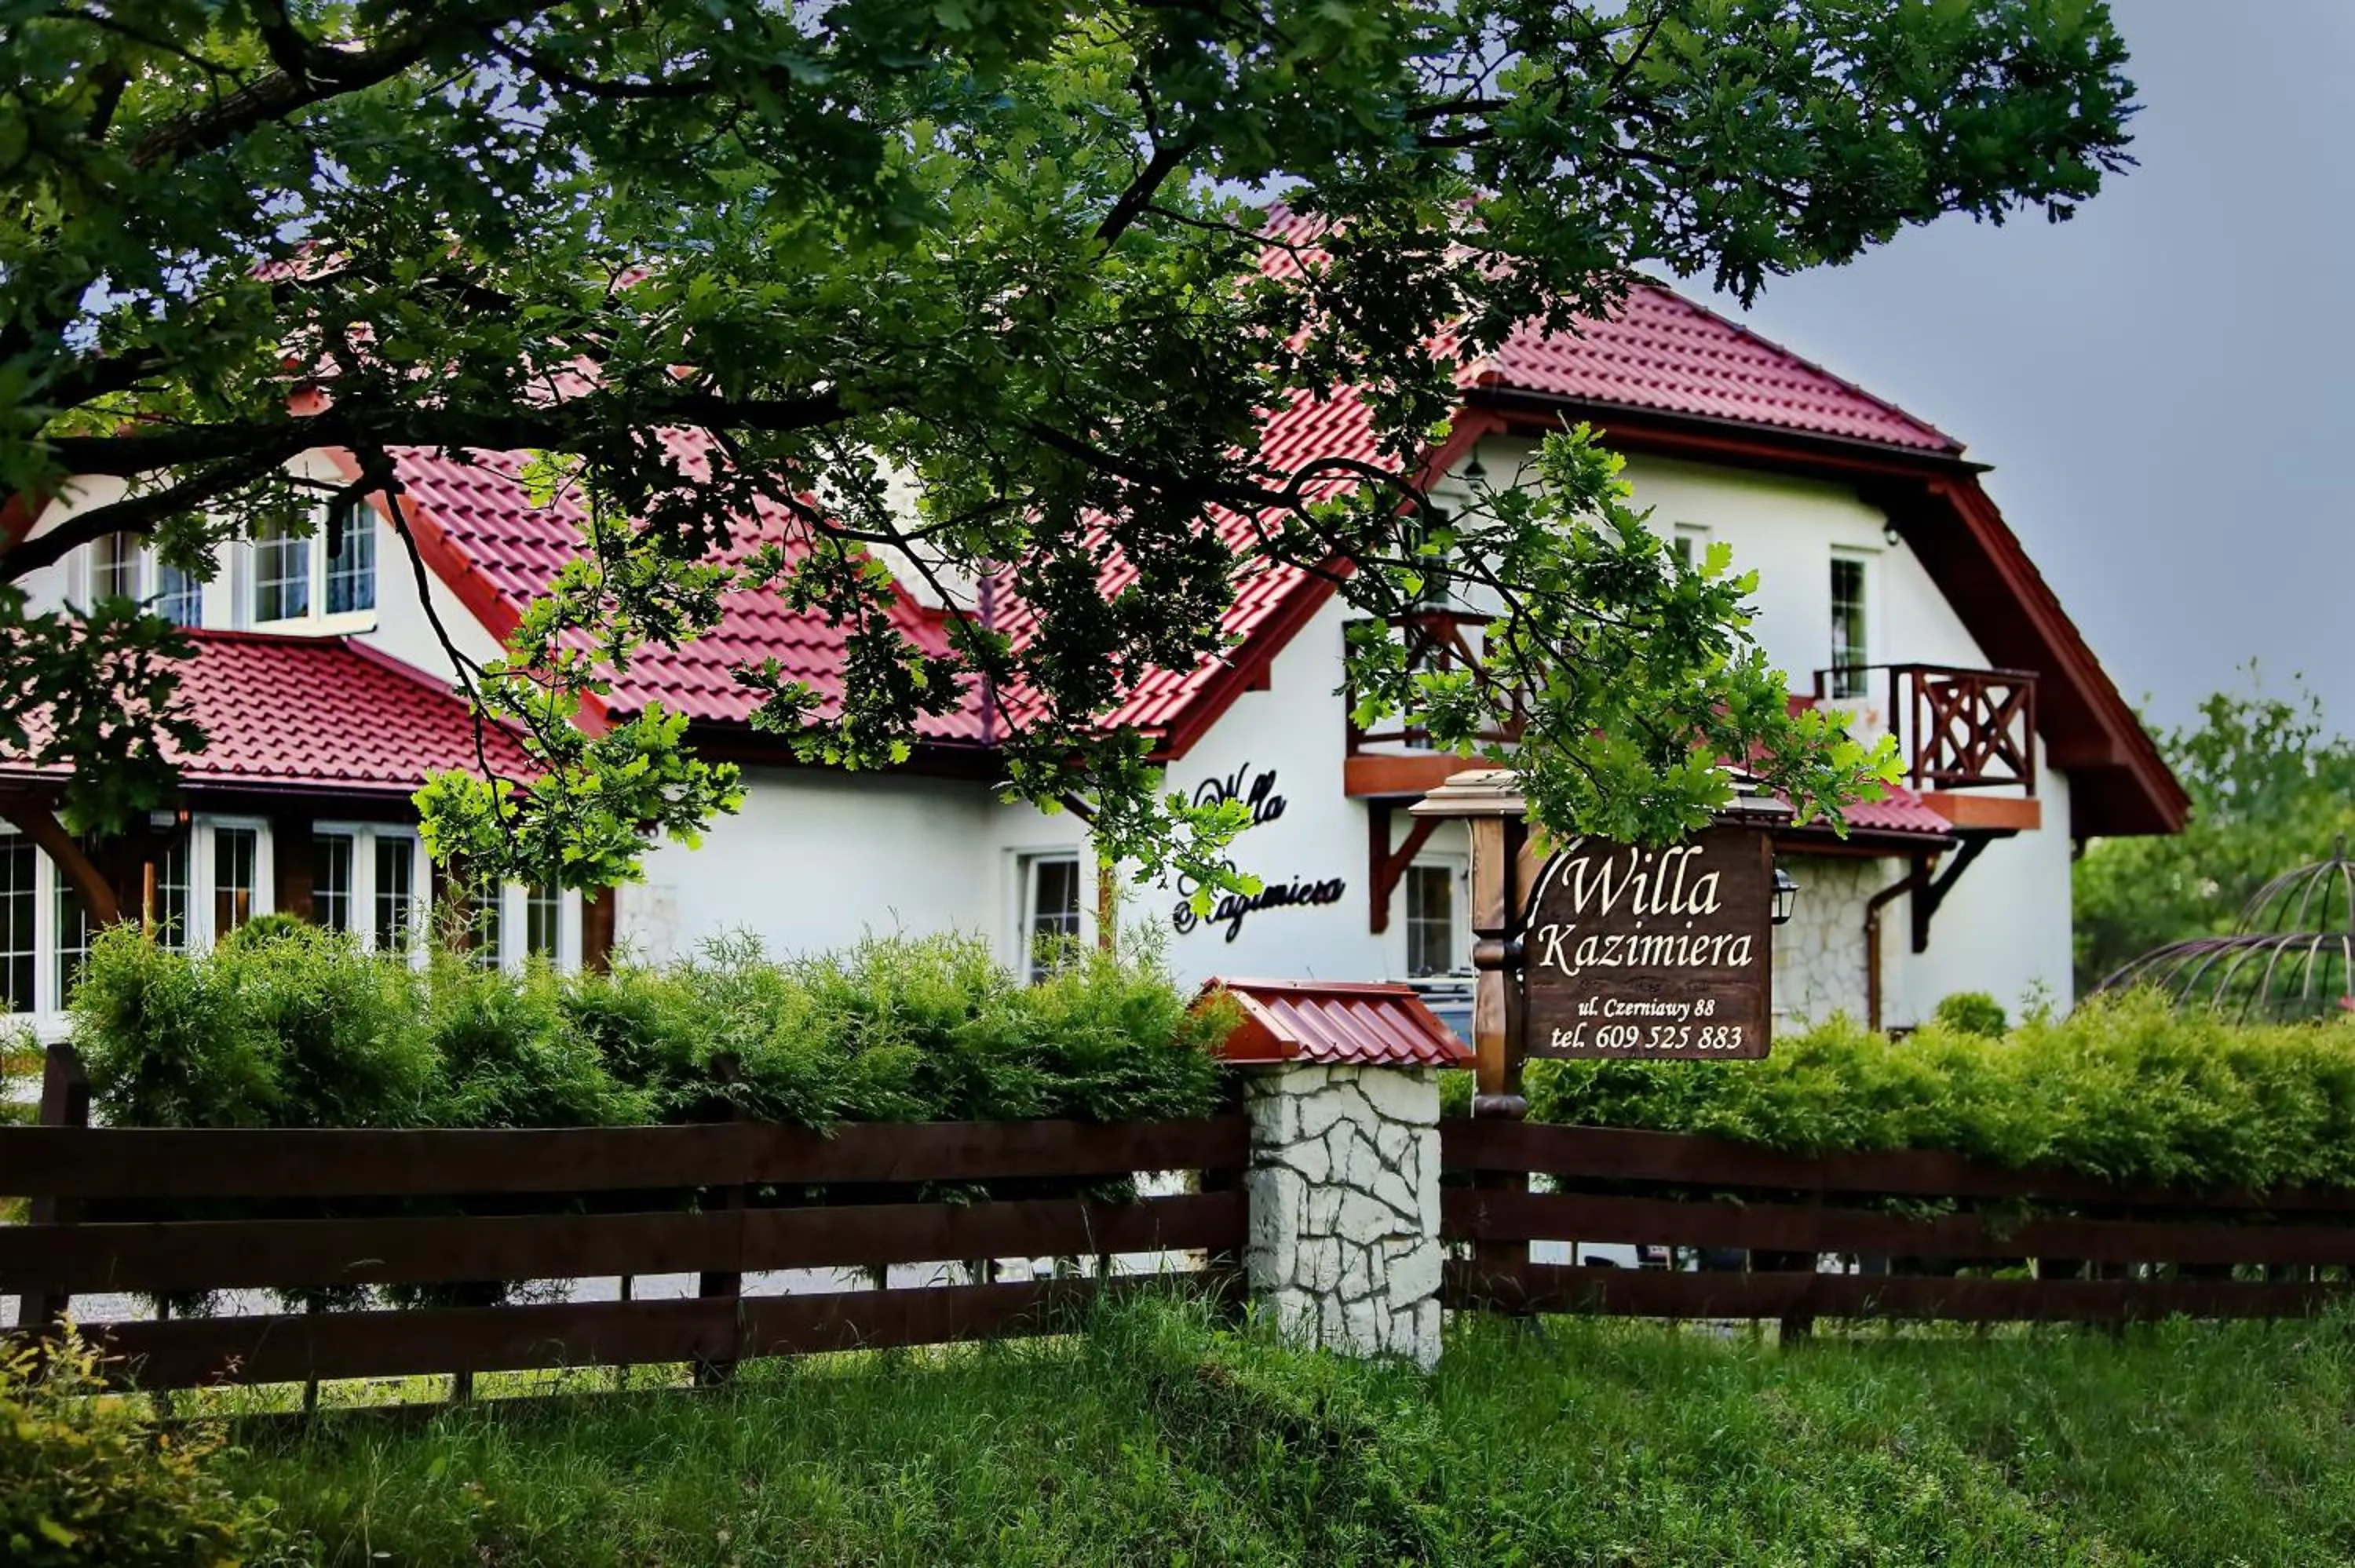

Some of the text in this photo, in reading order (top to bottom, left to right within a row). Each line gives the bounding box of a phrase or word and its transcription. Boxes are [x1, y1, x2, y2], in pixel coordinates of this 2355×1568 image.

[1193, 761, 1287, 826] Wlla
[1561, 845, 1722, 916] Willa
[1539, 921, 1753, 976] Kazimiera
[1551, 1022, 1742, 1048] tel. 609 525 883
[1578, 996, 1715, 1022] ul. Czerniawy 88
